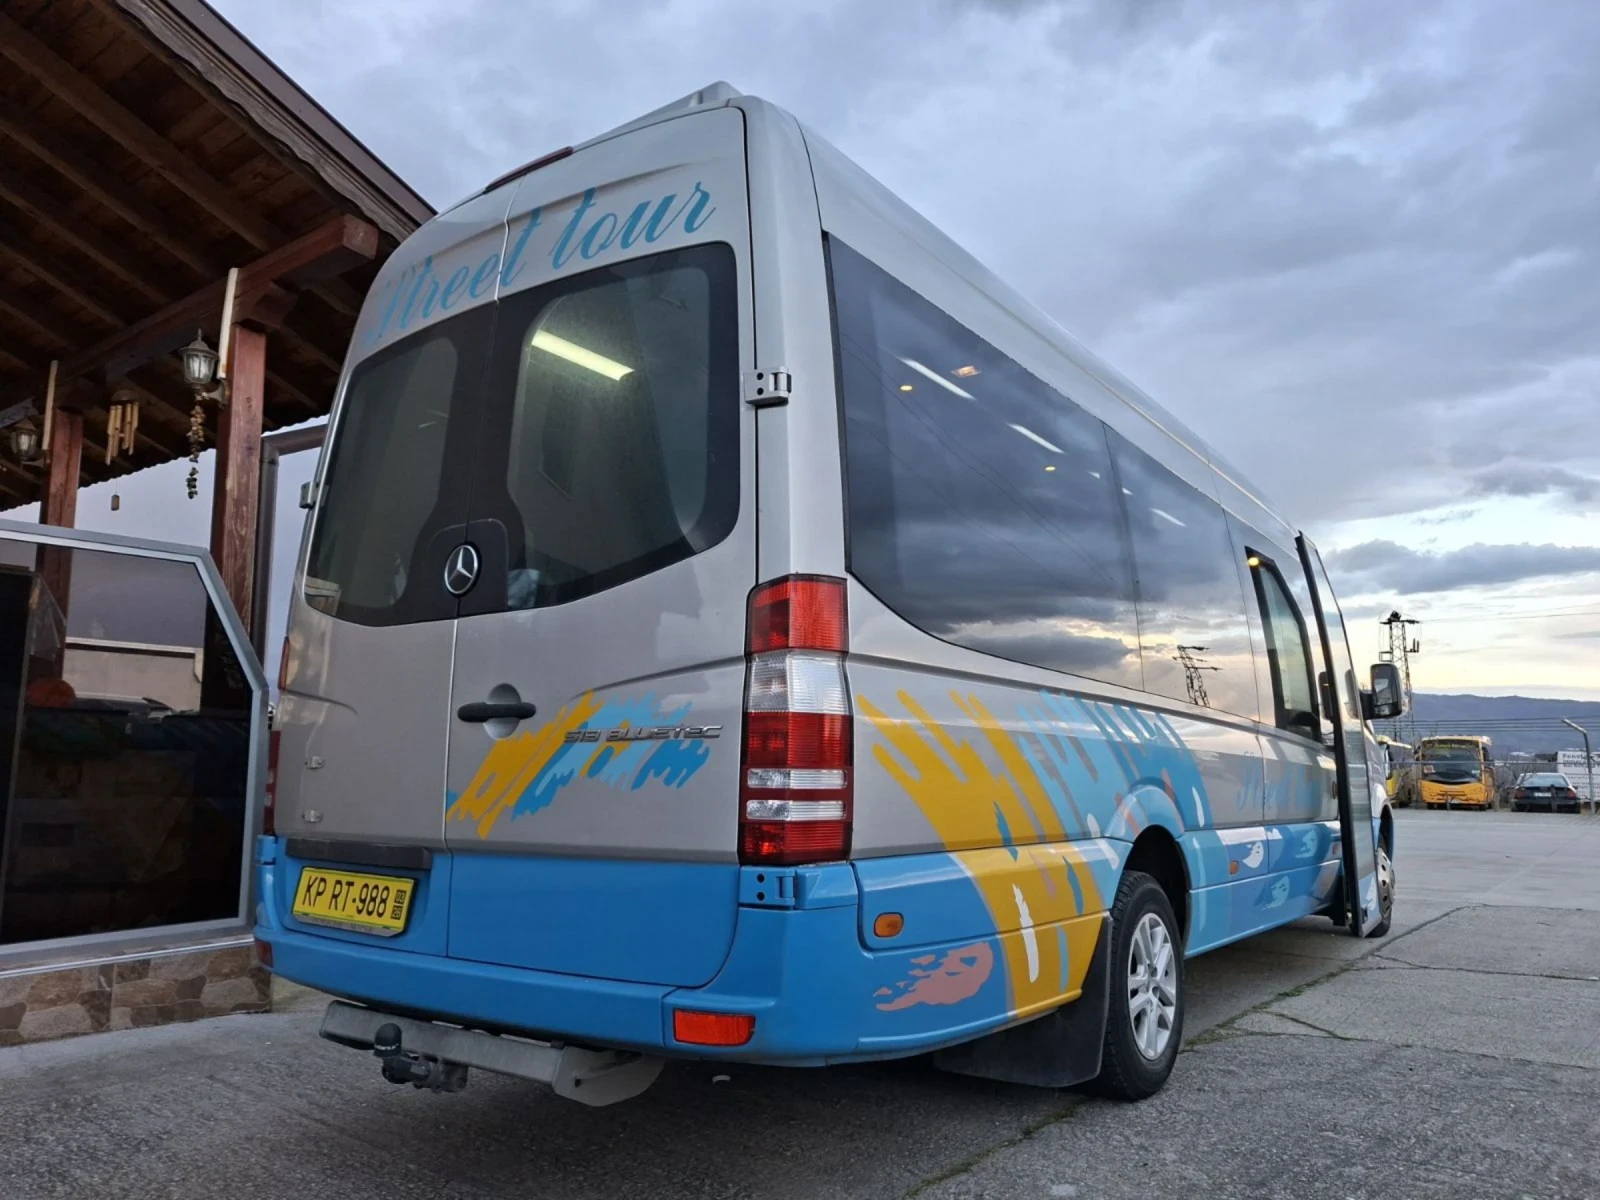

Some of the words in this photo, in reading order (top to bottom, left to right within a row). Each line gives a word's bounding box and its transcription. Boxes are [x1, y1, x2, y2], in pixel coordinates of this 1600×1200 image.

[548, 181, 716, 270] tour
[605, 725, 723, 742] BLUETEC
[301, 875, 328, 908] KP
